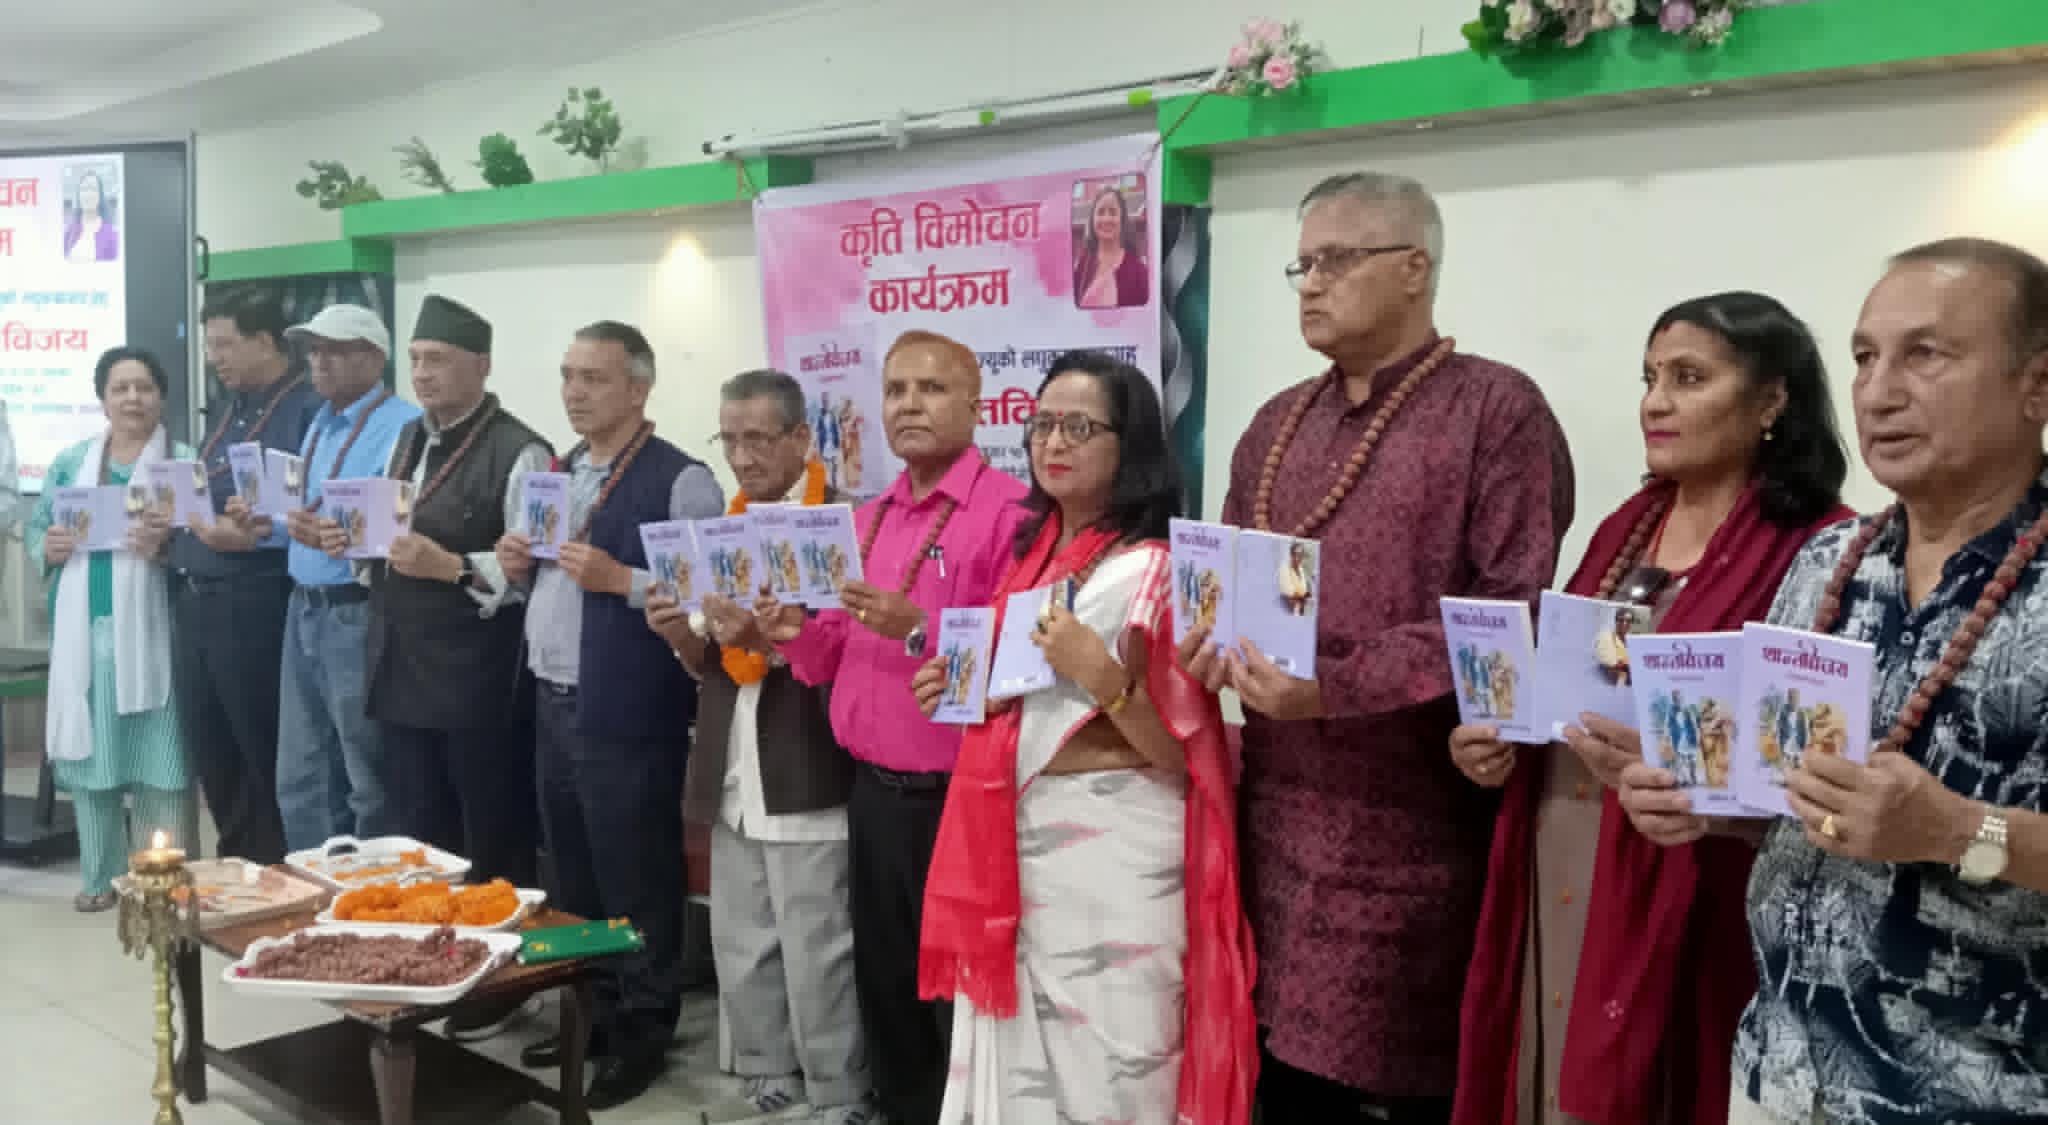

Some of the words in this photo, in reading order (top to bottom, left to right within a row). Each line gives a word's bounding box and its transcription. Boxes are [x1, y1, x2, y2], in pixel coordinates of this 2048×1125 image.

[840, 207, 904, 267] कृति
[914, 198, 1041, 252] विमोचन
[868, 264, 1012, 314] कार्यक्रम
